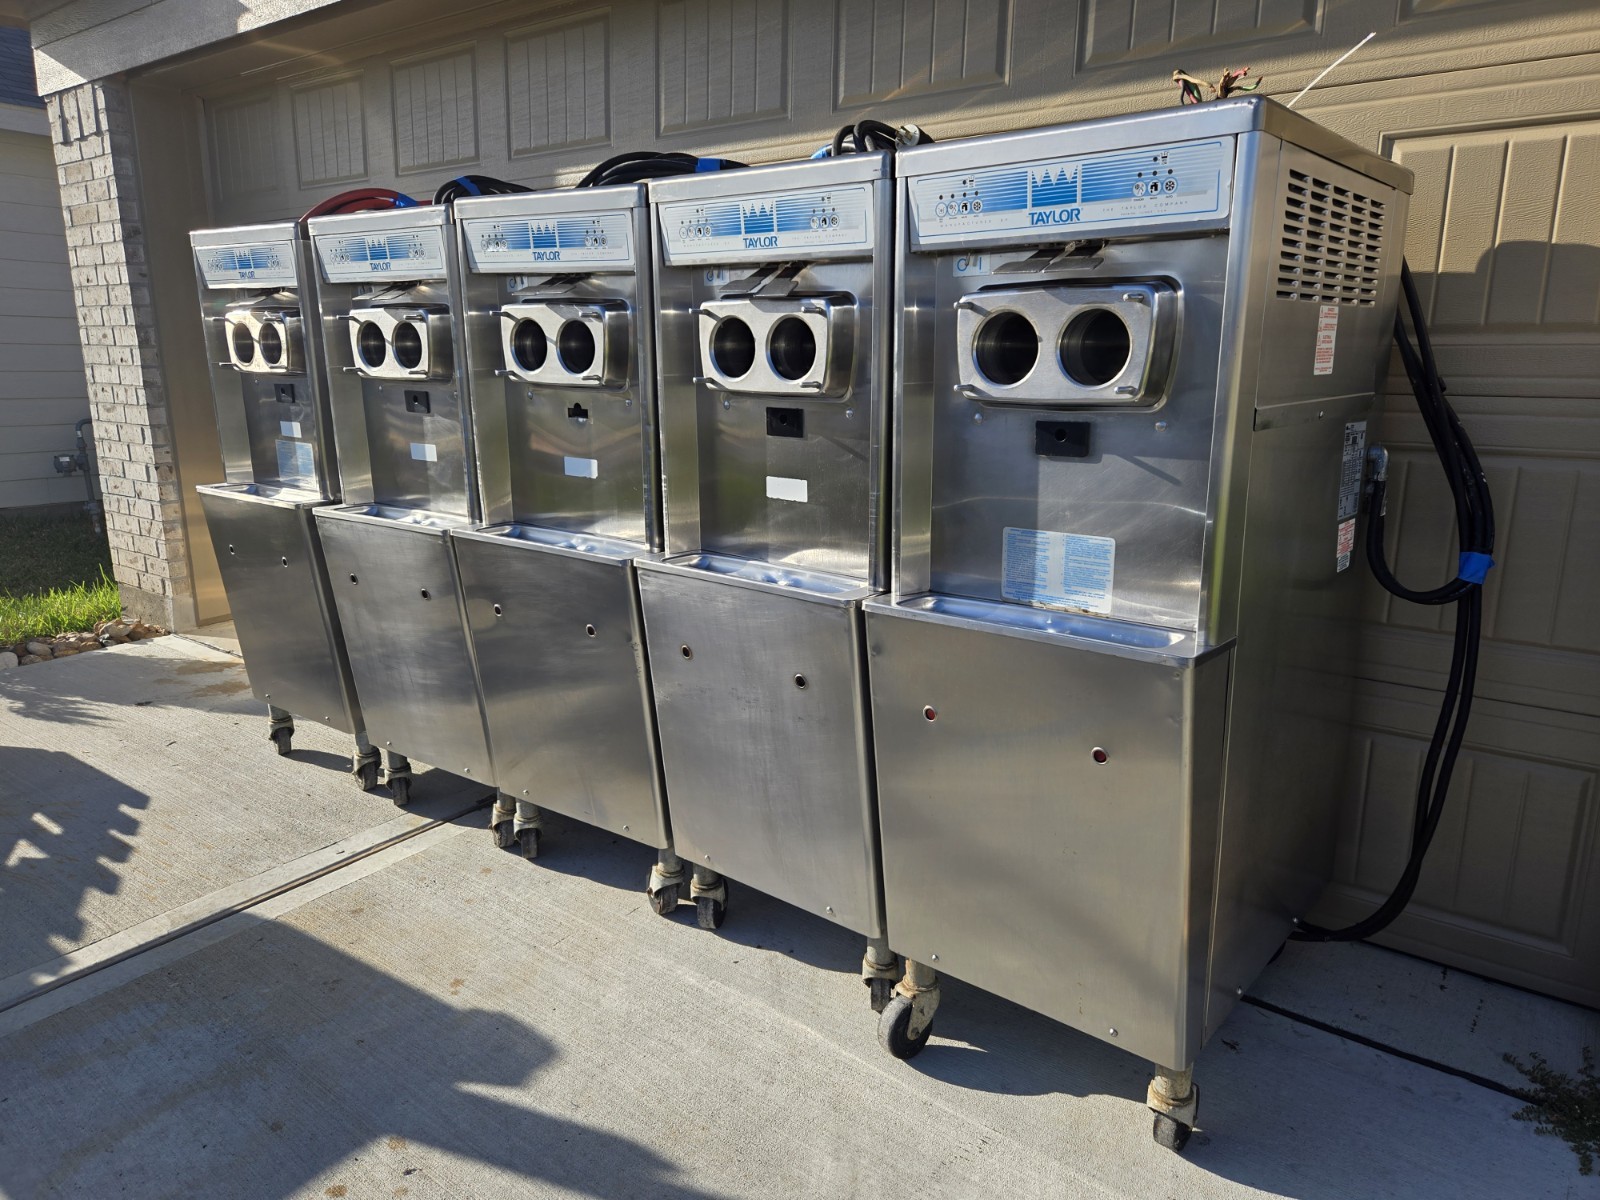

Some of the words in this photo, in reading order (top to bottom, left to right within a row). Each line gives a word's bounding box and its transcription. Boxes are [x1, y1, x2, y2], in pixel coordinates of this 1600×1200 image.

[1028, 208, 1081, 226] TAYLOR
[743, 235, 778, 249] TAYLOR
[532, 251, 561, 261] TAYLOR
[369, 262, 392, 271] TAYLOR
